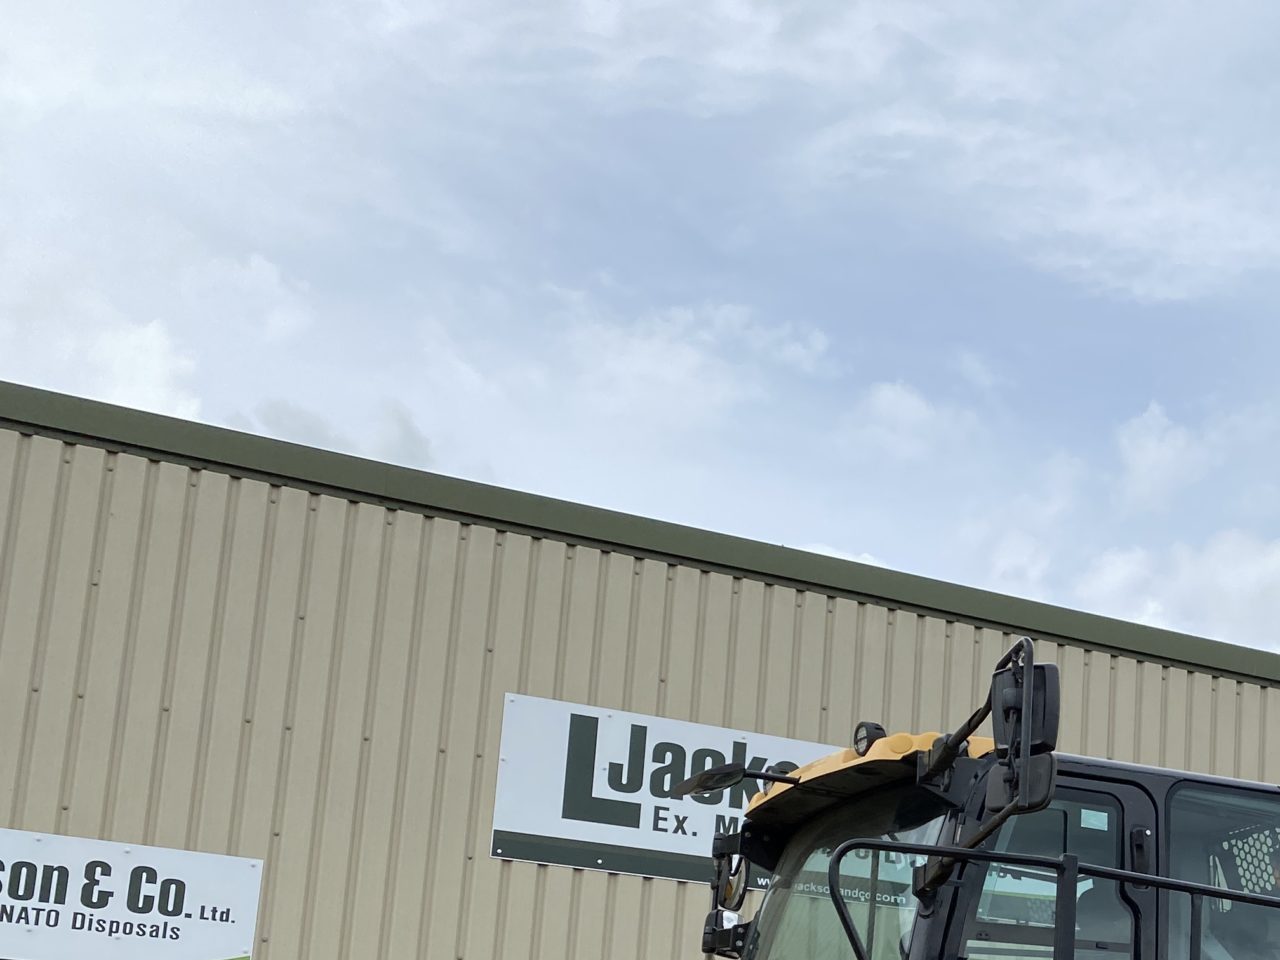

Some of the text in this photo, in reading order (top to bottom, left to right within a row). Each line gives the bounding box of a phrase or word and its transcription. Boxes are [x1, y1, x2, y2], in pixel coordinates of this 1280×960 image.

[652, 806, 697, 836] Ex.
[0, 859, 236, 923] on & Co. Ltd.
[0, 904, 181, 940] NATO Disposals
